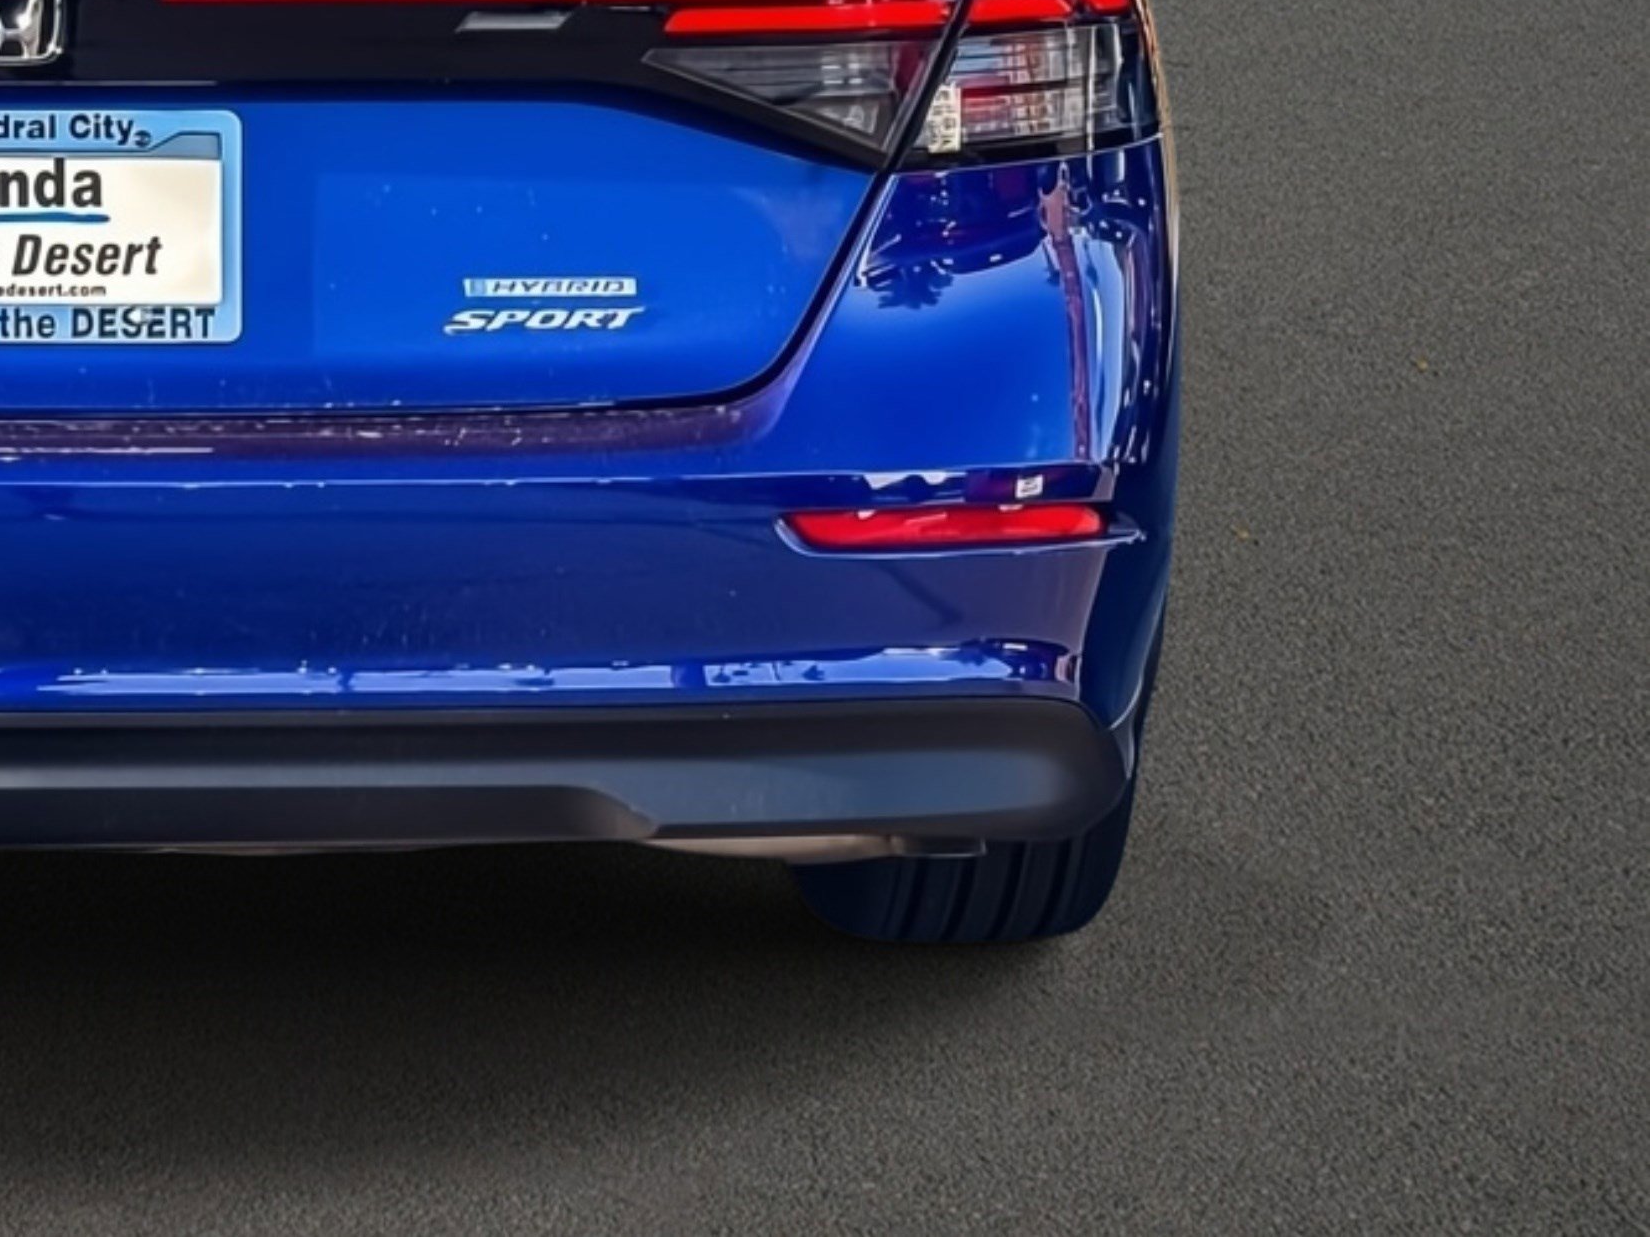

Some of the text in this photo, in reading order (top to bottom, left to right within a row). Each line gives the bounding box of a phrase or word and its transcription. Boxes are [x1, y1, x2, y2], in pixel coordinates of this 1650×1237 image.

[68, 114, 135, 146] City
[11, 234, 163, 276] Desert
[491, 279, 626, 294] HYBRID
[71, 307, 216, 339] DESERT
[443, 306, 646, 335] SPORT
